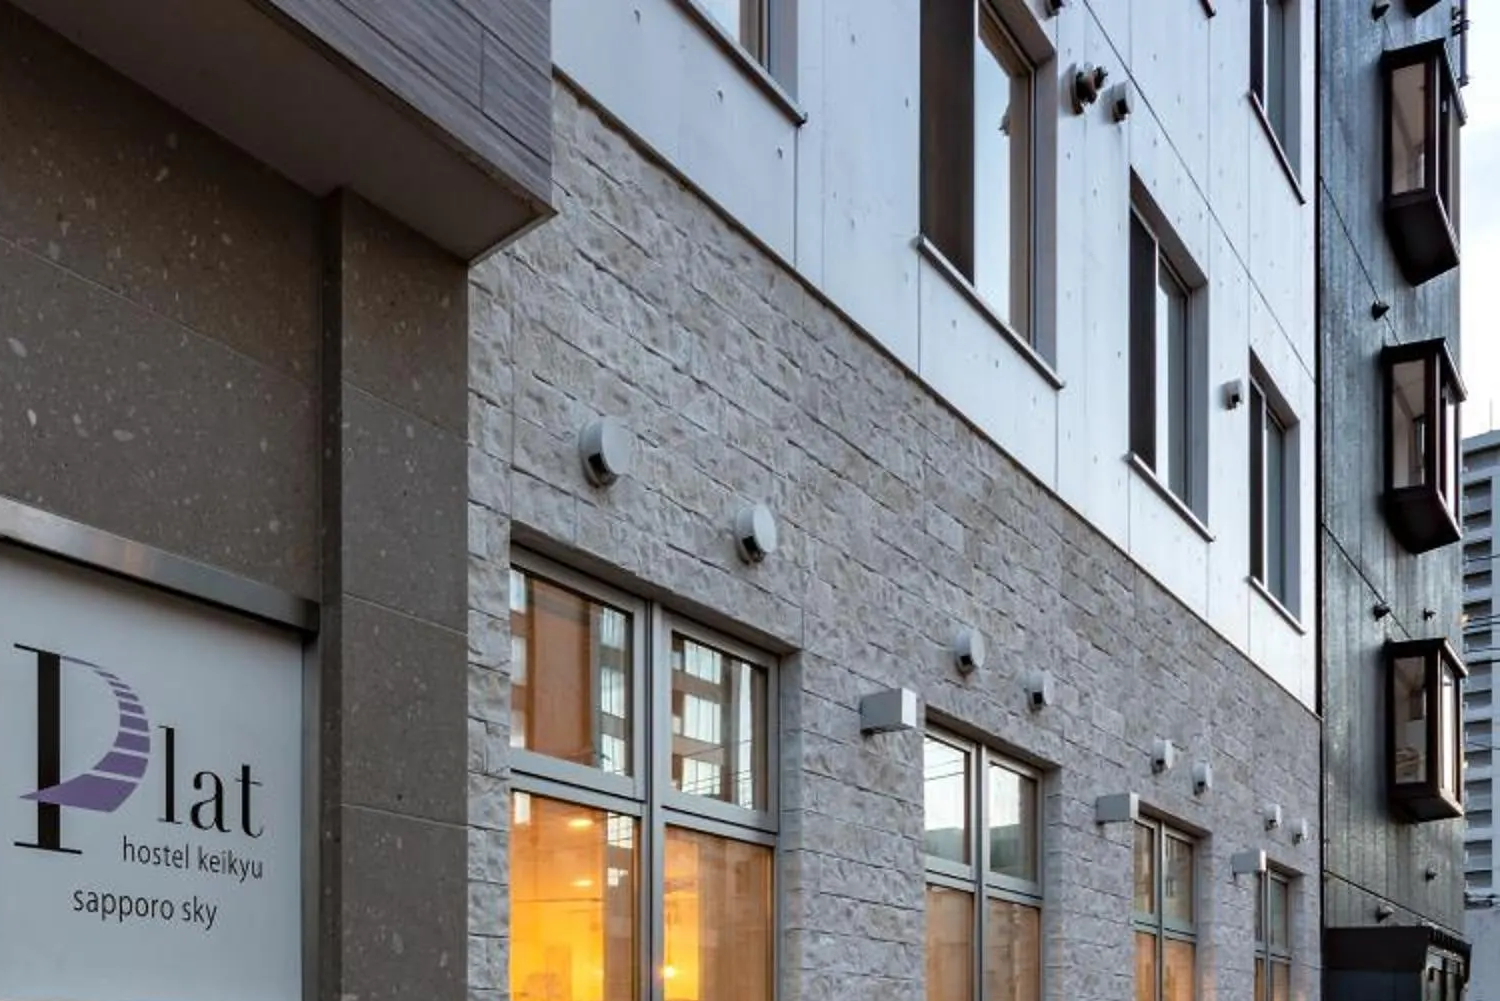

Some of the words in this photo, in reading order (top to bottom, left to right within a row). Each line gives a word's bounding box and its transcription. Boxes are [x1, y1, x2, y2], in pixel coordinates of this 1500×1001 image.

[13, 643, 265, 854] Plat
[122, 835, 190, 869] hostel
[198, 846, 264, 882] keikyu
[73, 889, 174, 922] sapporo
[182, 896, 218, 931] sky
